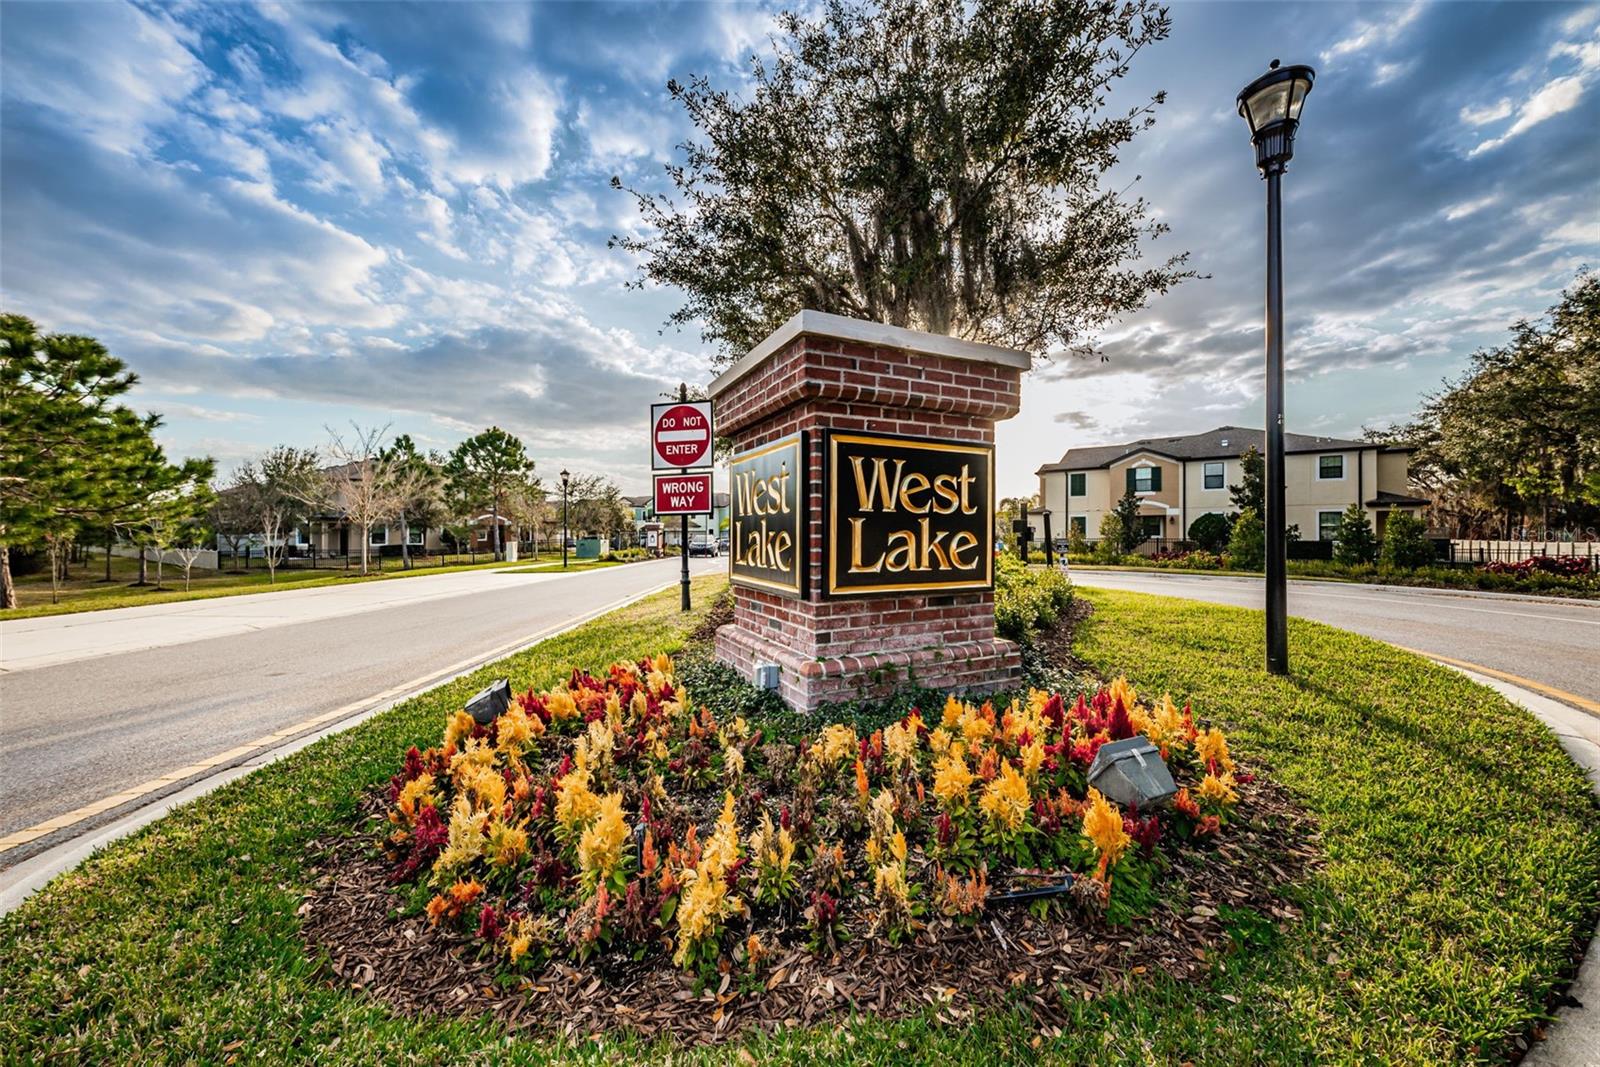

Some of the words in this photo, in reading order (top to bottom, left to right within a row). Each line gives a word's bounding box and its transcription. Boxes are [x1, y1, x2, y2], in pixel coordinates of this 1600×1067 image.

[662, 418, 675, 428] DO
[683, 416, 702, 426] NOT
[666, 445, 698, 455] ENTER
[662, 481, 704, 494] WRONG
[670, 496, 695, 507] WAY
[736, 461, 790, 517] West
[848, 456, 978, 515] West
[735, 518, 791, 571] Lake
[848, 517, 979, 573] Lake
